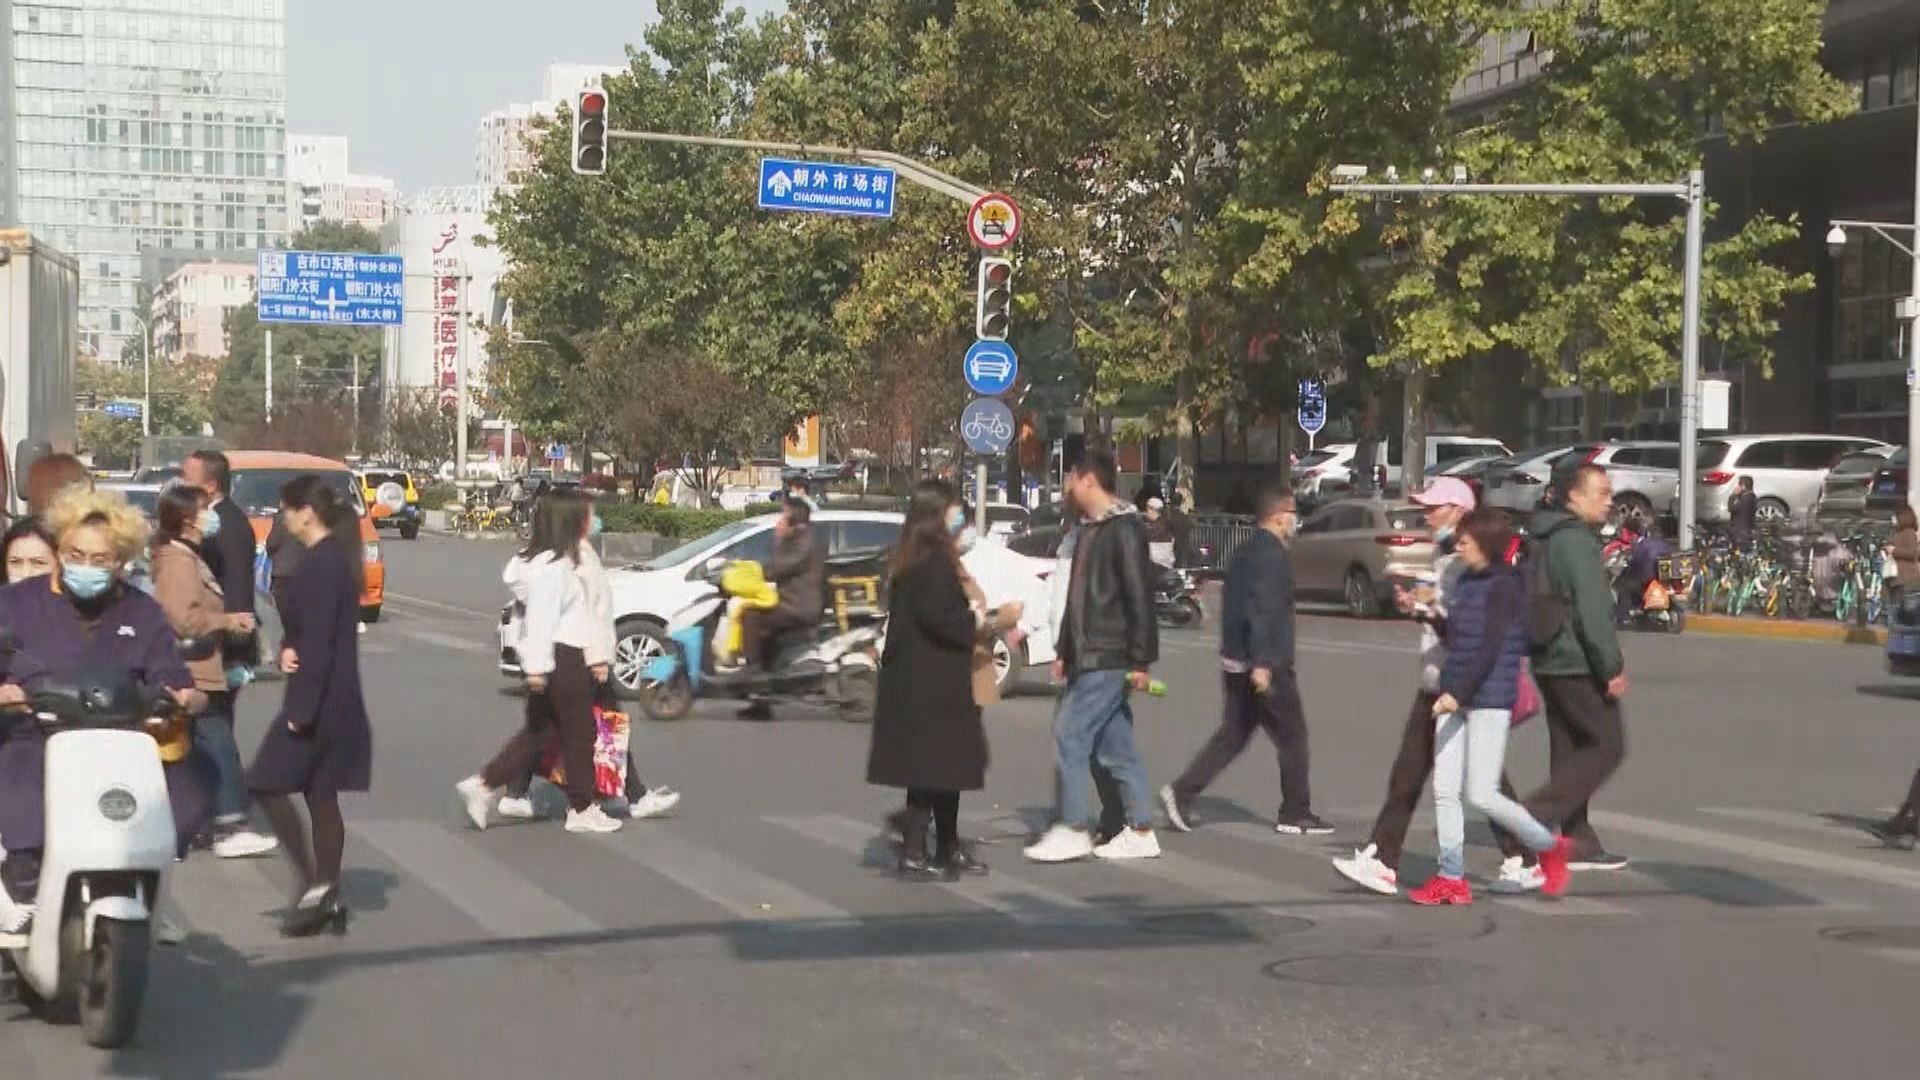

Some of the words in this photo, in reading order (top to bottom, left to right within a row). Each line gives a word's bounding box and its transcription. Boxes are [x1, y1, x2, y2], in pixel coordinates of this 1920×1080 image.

[793, 168, 888, 193] 朝外市场街
[793, 192, 872, 208] CHAOWAISHICHANG
[297, 255, 354, 271] 吉市口东路
[260, 278, 320, 294] 朝阳门外大街
[345, 280, 402, 297] 朝阳门外大街
